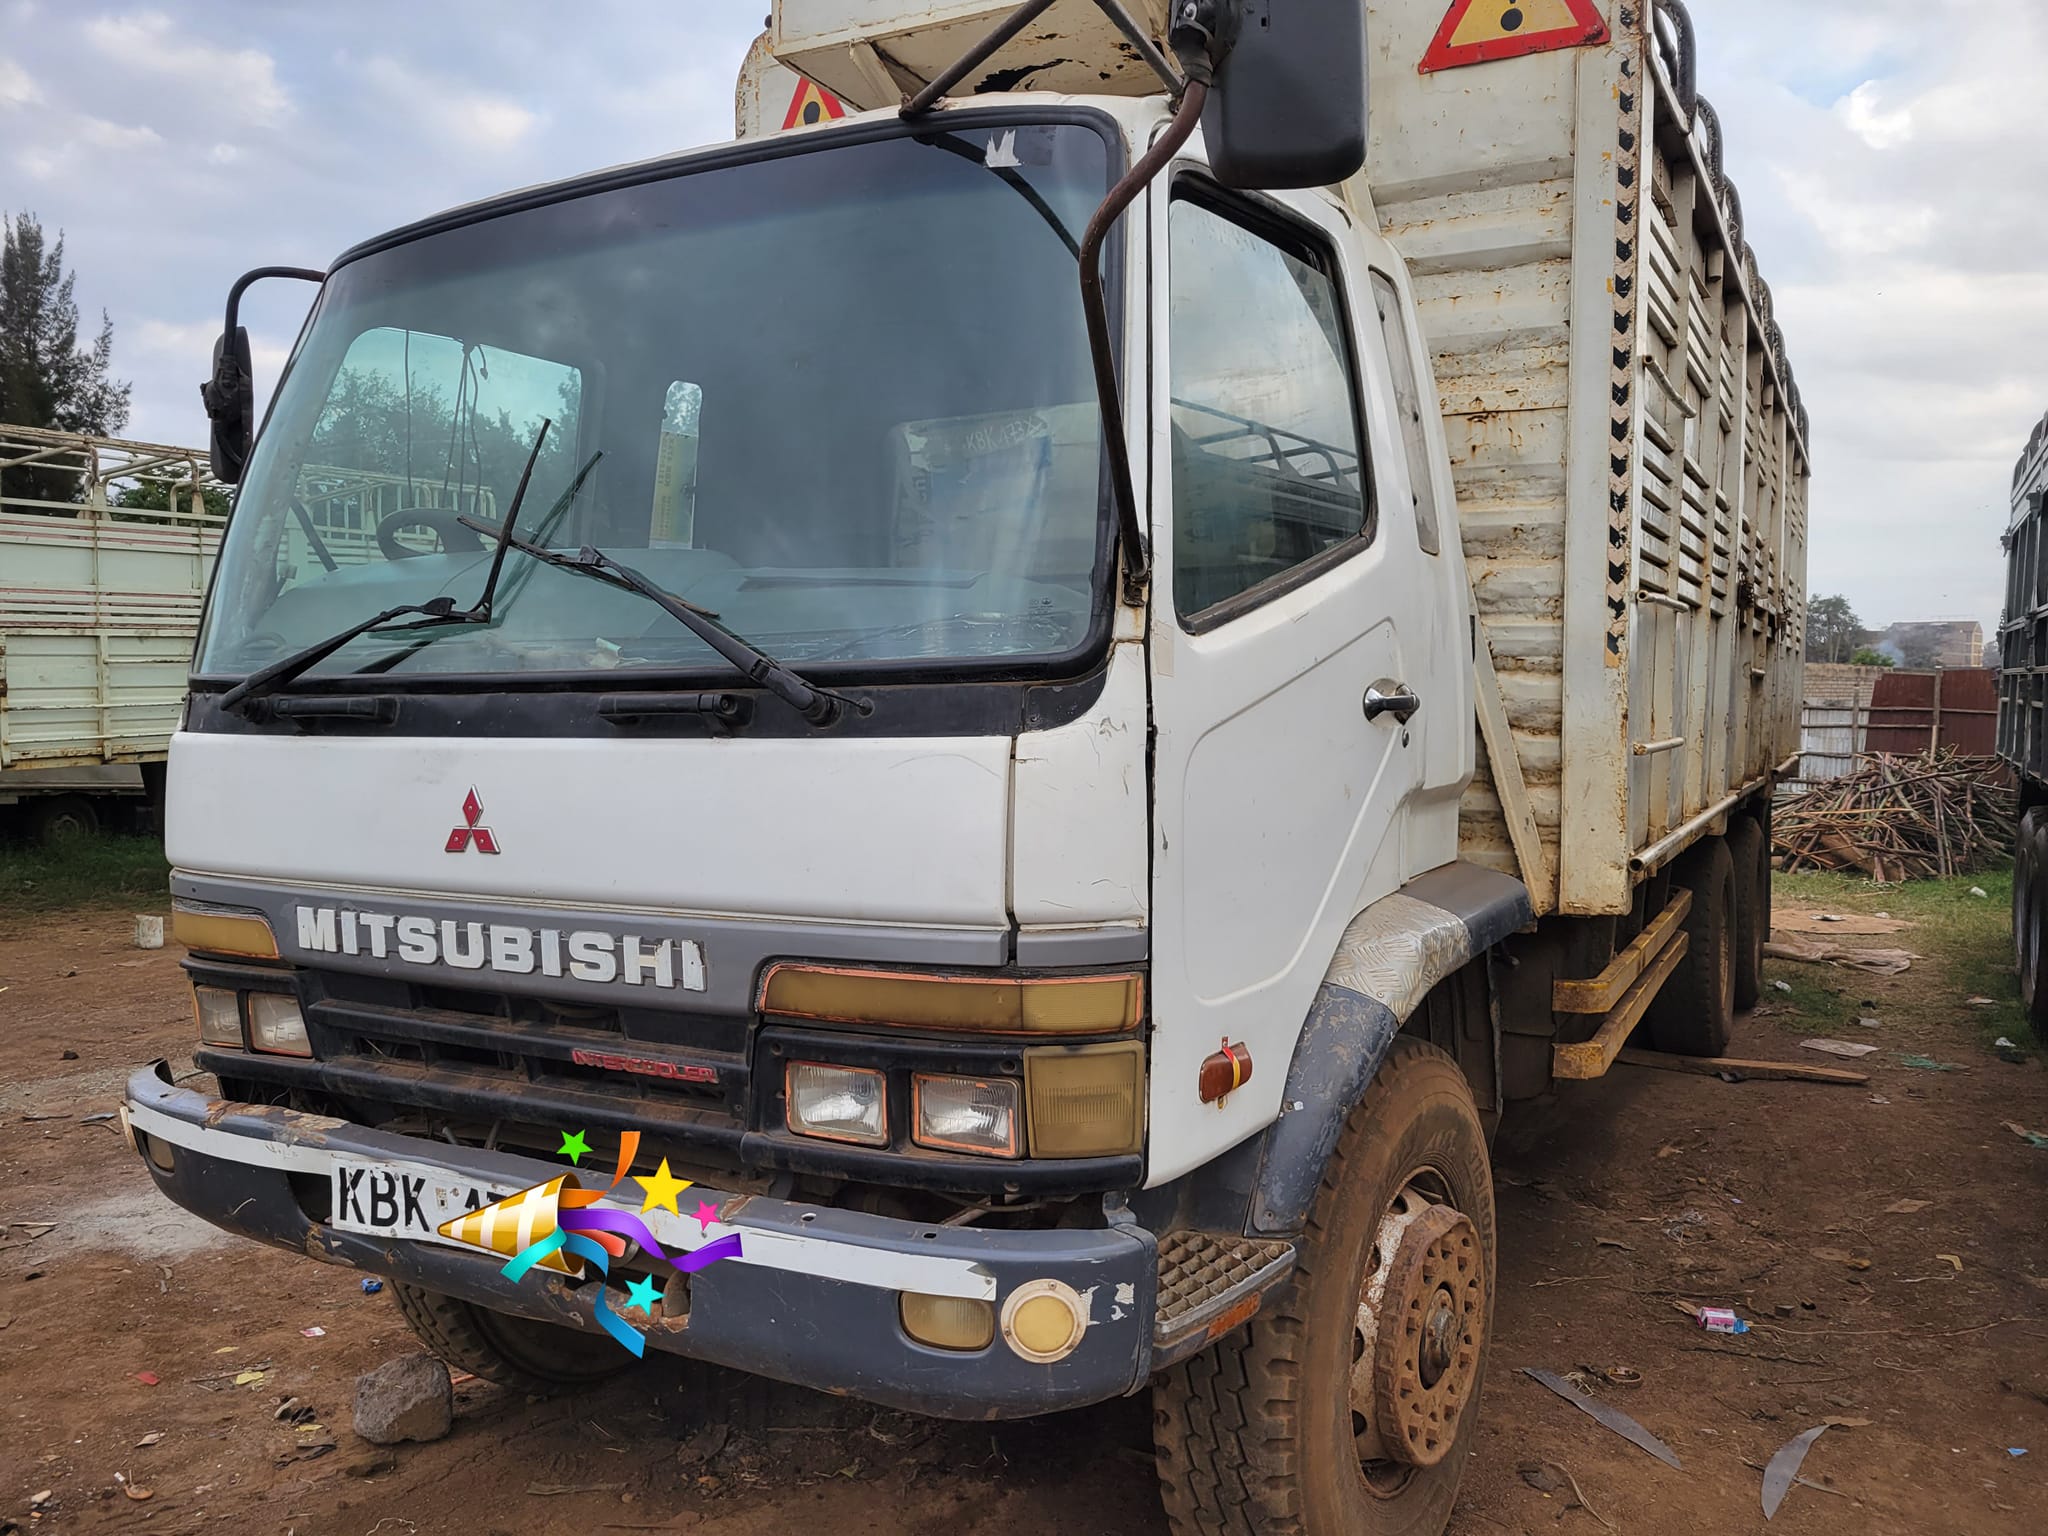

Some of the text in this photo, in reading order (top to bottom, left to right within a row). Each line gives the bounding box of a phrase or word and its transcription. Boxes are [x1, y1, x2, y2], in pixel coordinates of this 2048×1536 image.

[296, 906, 707, 992] MITSUBISHI
[572, 1048, 719, 1084] INTERCOOLER
[339, 1167, 430, 1232] KBK
